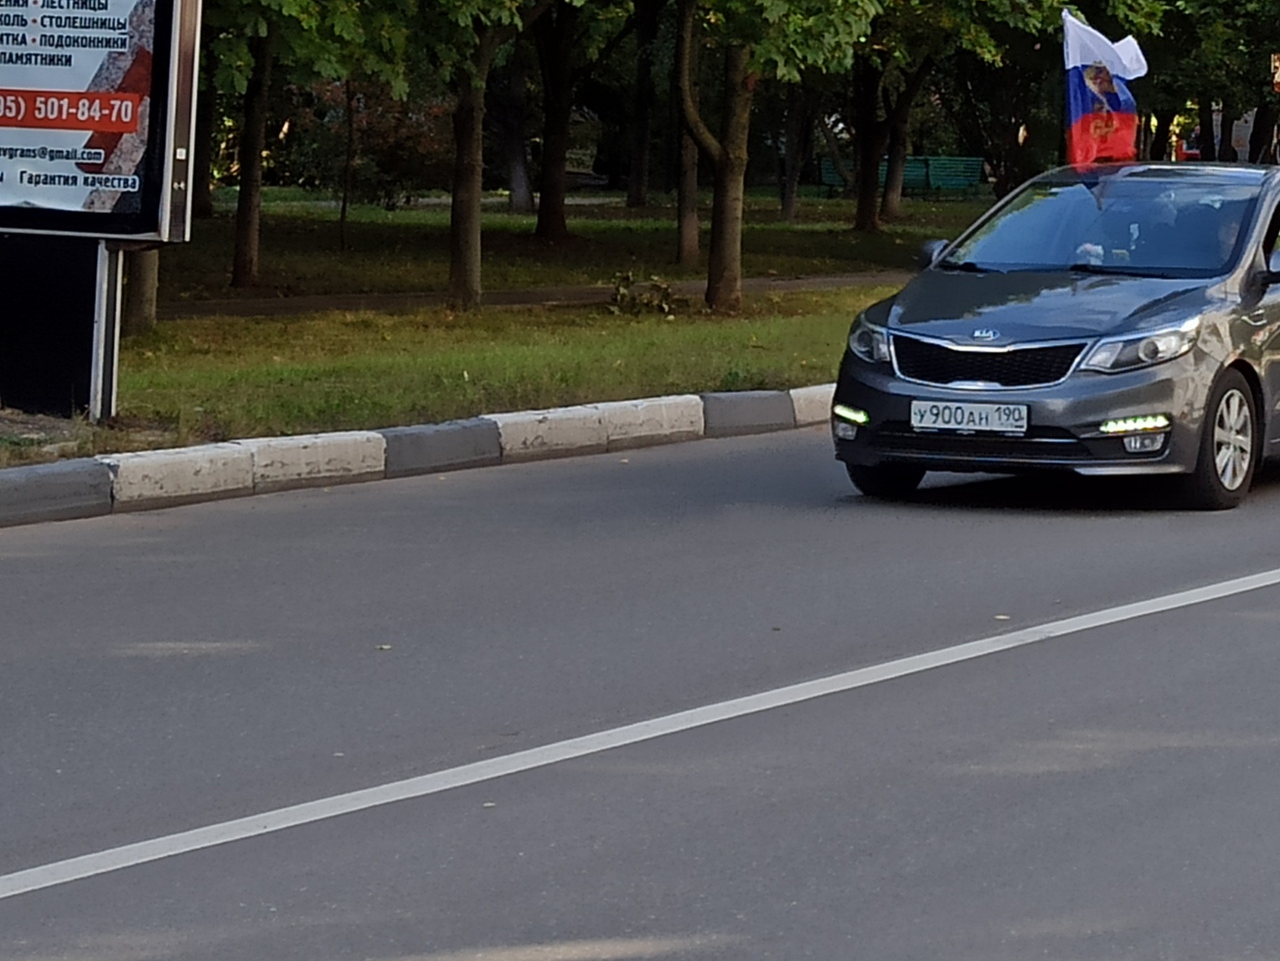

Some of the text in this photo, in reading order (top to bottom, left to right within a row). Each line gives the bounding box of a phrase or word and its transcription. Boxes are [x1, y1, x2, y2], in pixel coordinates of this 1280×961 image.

[40, 15, 127, 31] СТОЛЕШНИЦЫ
[39, 34, 127, 49] ПОДОКОННИКИ
[0, 52, 72, 67] ПАМЯТНИКИ
[35, 97, 132, 122] 501-84-70
[20, 170, 78, 187] Гарантия
[83, 175, 138, 190] качества
